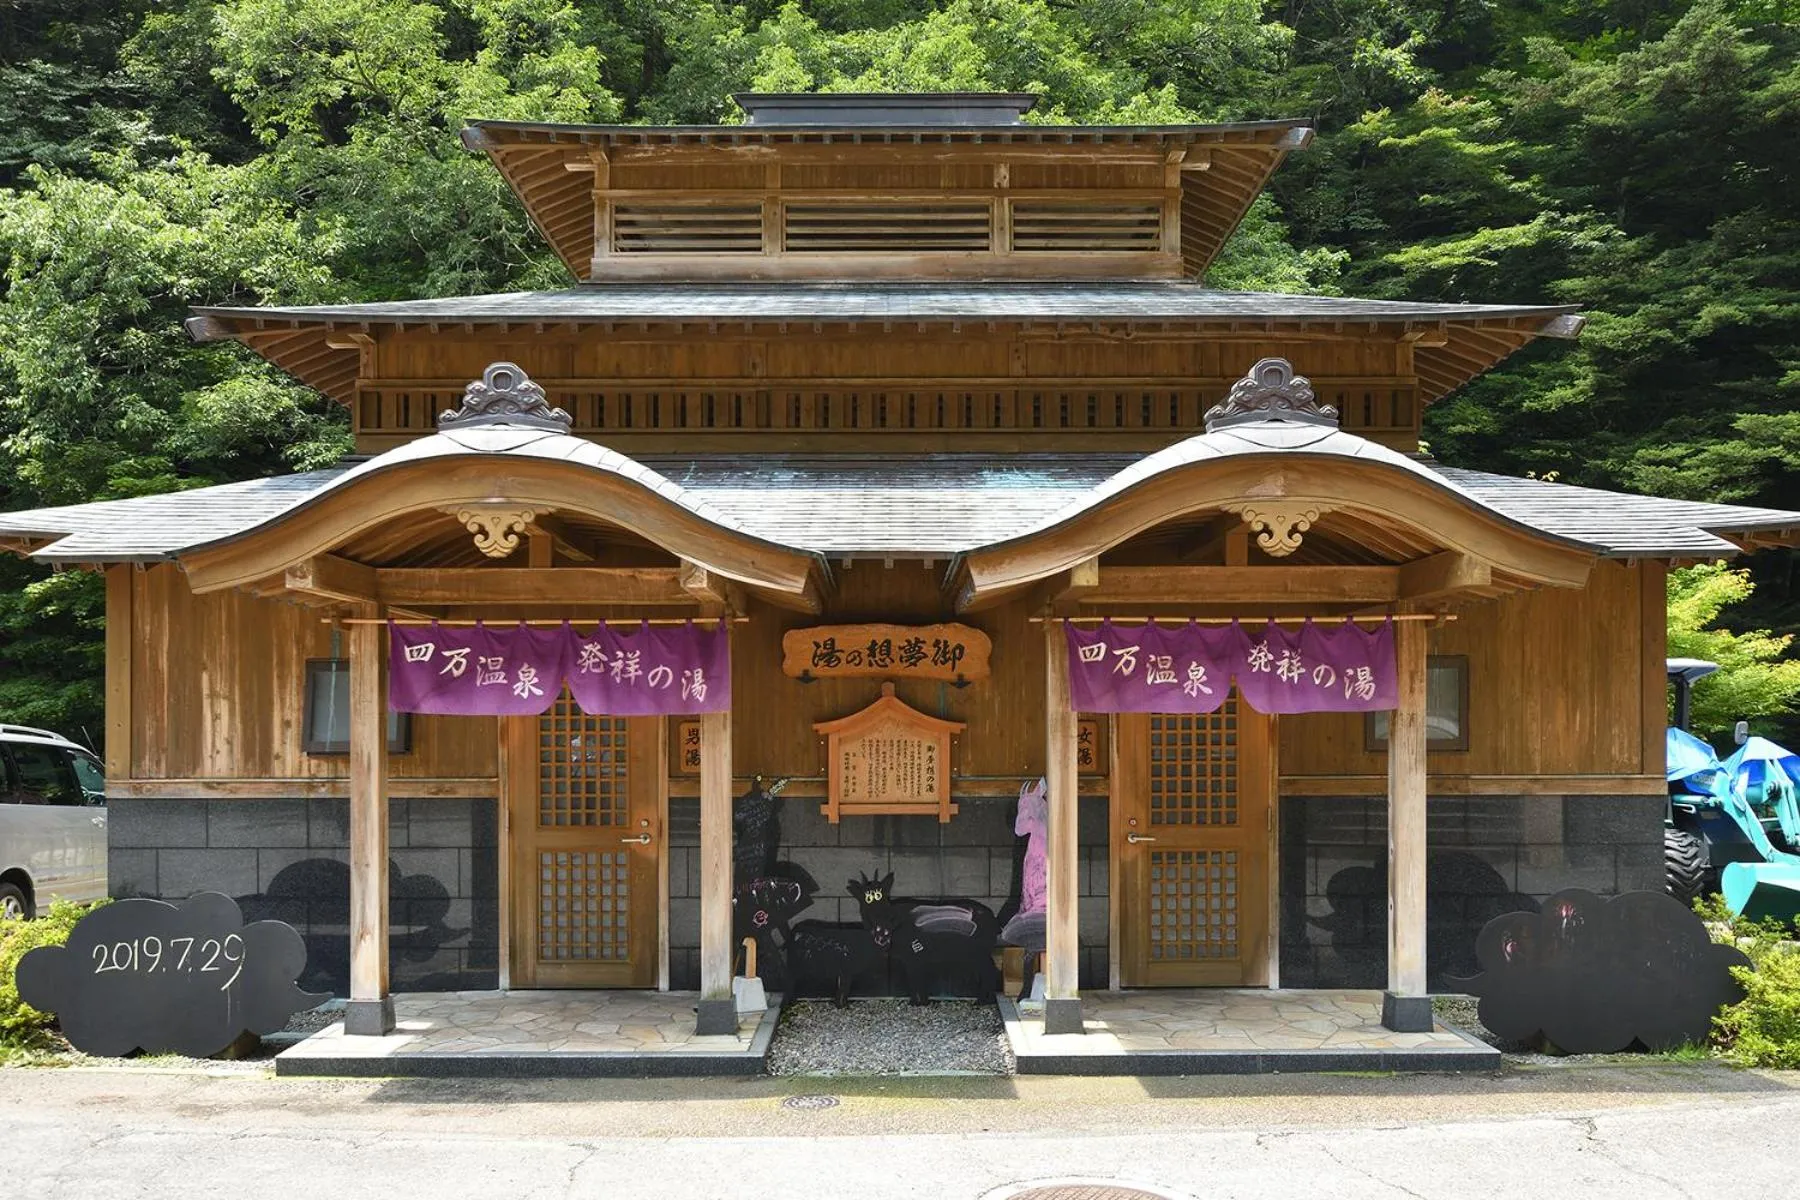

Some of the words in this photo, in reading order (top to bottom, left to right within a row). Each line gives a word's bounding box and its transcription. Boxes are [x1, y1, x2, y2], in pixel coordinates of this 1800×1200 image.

[404, 642, 544, 699] 四万温泉
[576, 642, 708, 703] 発祥の湯
[1078, 642, 1213, 697] 四万温泉
[1247, 640, 1376, 701] 発祥の湯
[685, 727, 702, 767] 男湯
[92, 936, 246, 991] 2019.7.29
